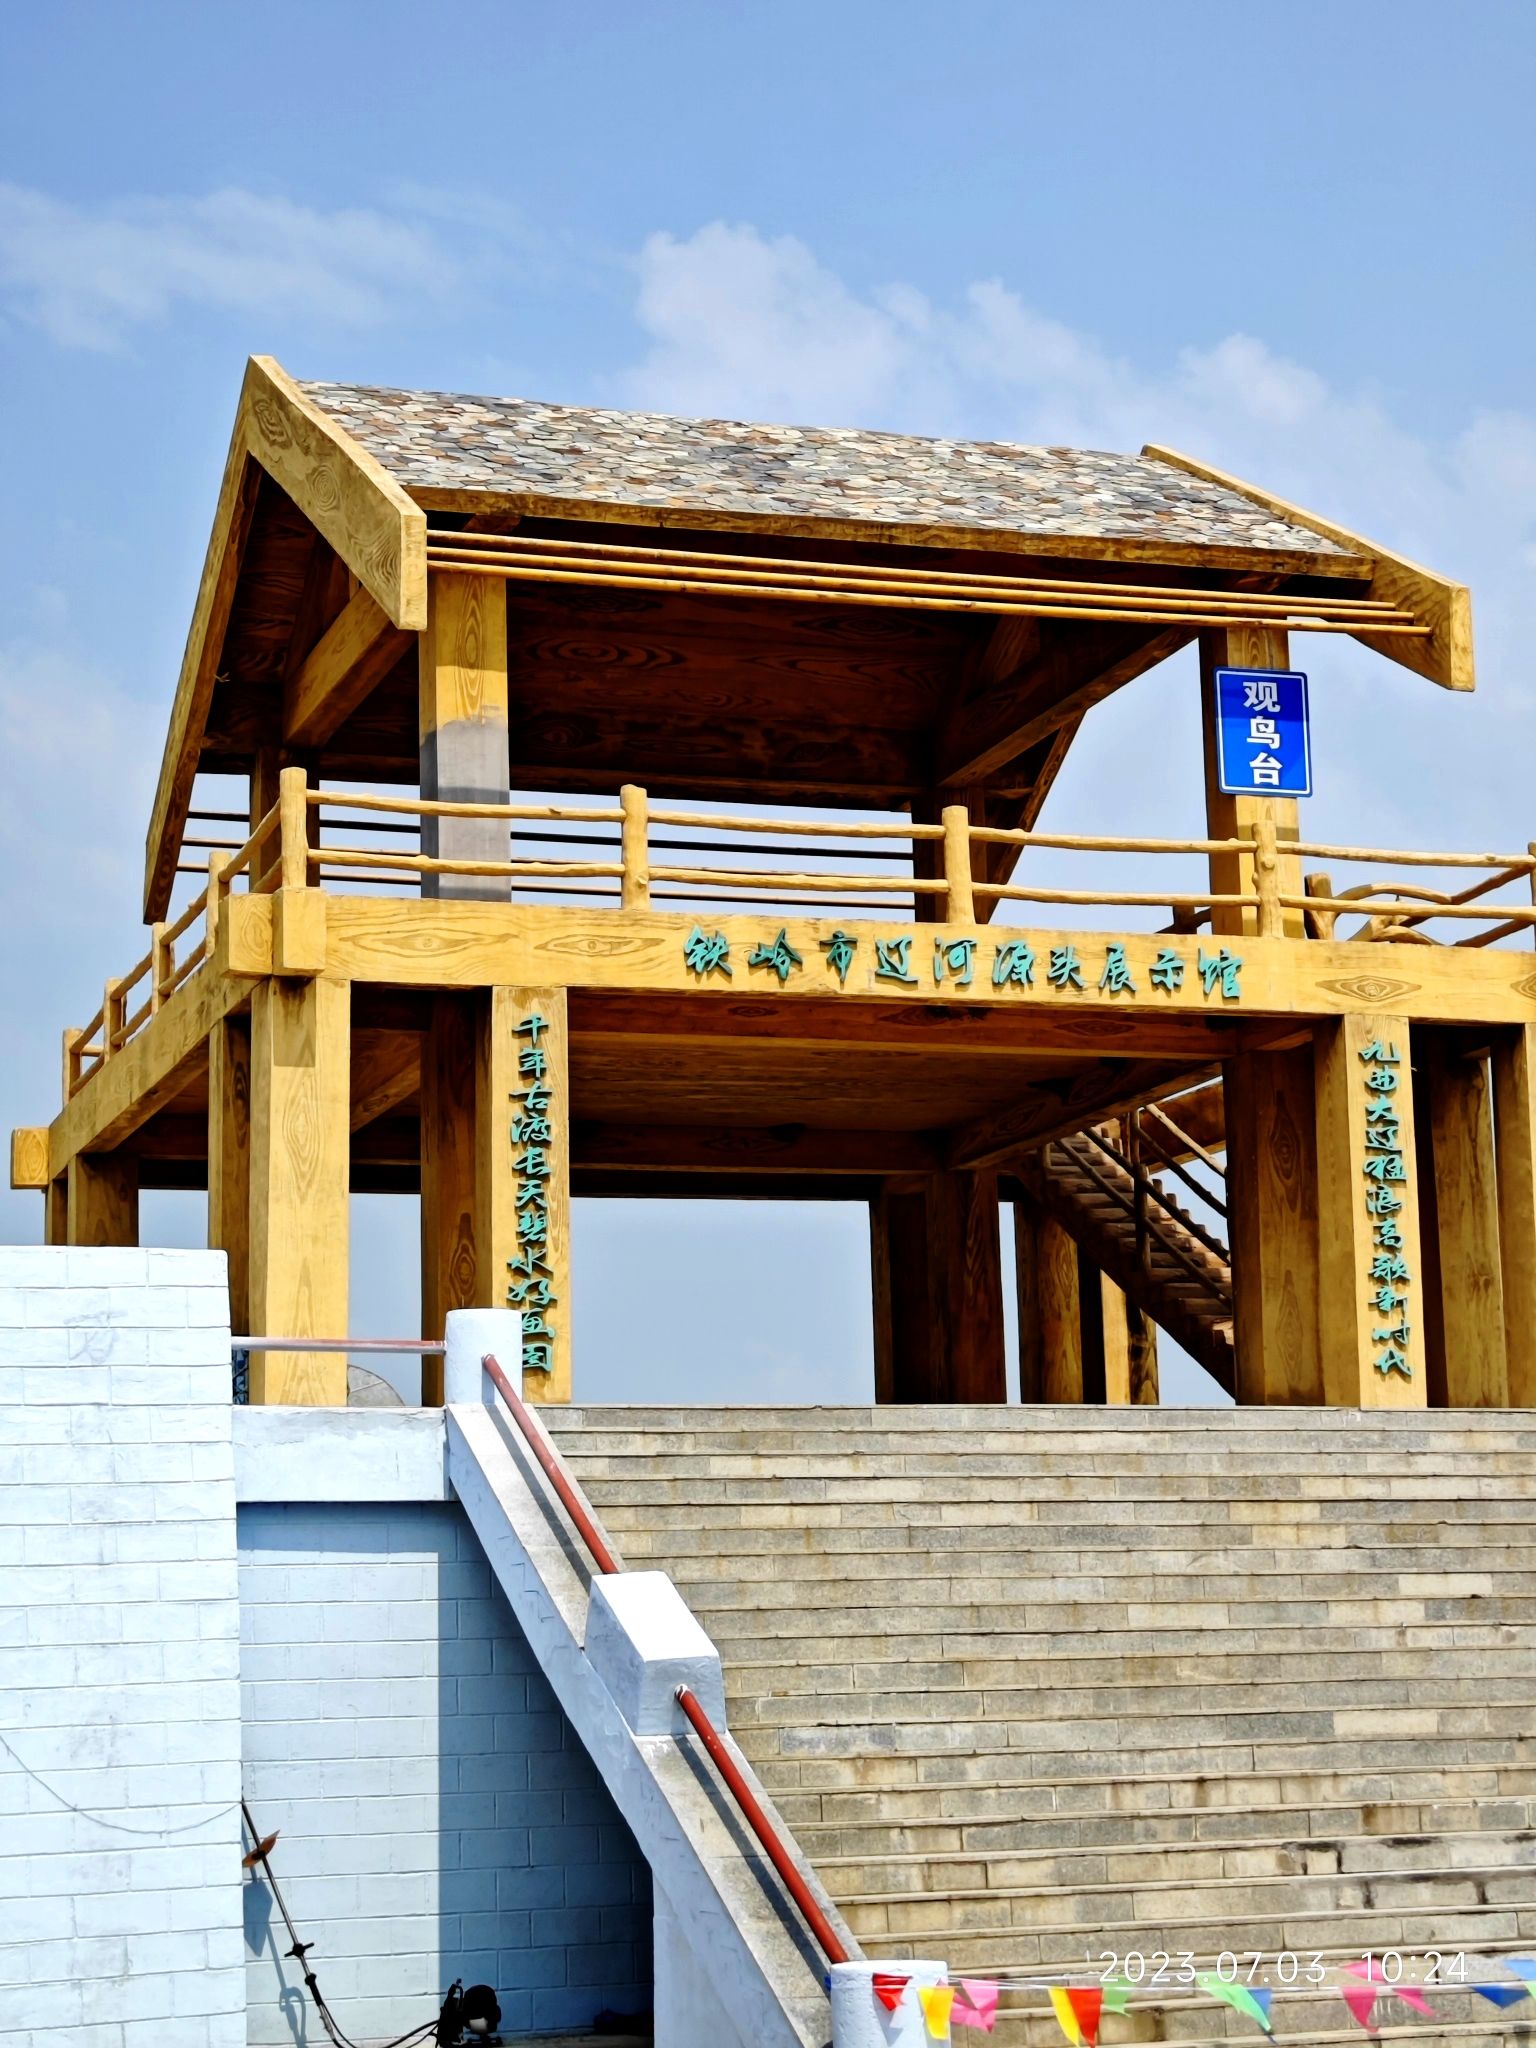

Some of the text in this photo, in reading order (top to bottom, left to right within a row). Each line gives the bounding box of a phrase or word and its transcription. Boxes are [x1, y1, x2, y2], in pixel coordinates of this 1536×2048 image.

[1243, 681, 1283, 786] 观鸟台
[685, 928, 1242, 997] 铁岭市辽河源头展示馆
